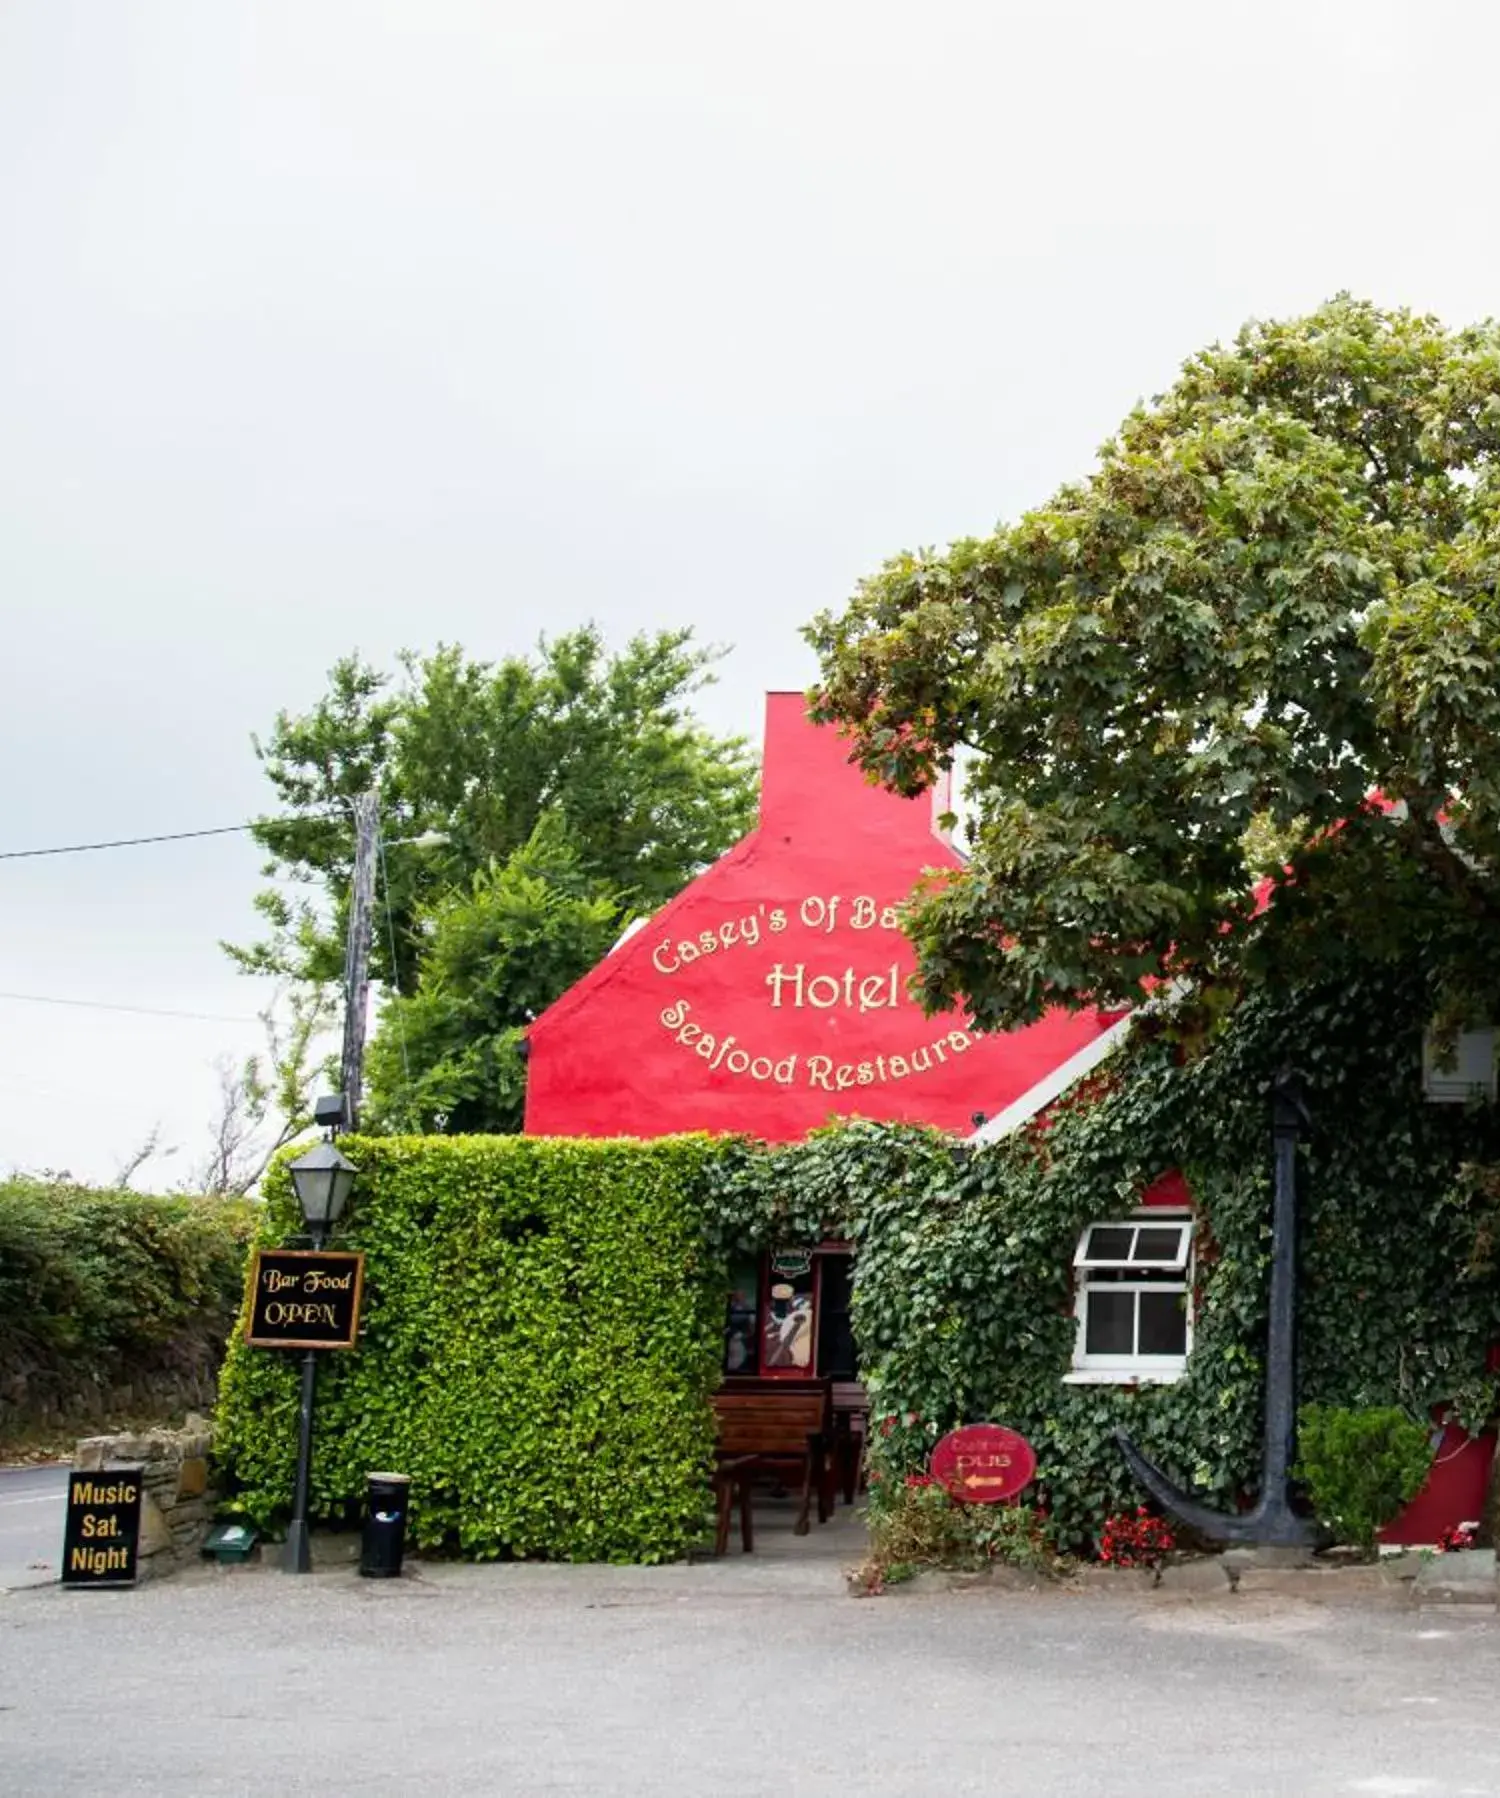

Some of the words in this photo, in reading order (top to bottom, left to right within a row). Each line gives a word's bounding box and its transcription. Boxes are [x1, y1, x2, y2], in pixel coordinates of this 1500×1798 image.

[652, 903, 787, 973] Casey's
[800, 895, 841, 934] Of
[850, 895, 899, 929] Ba
[765, 963, 899, 1013] Hotel
[660, 999, 798, 1084] Seafood
[806, 1027, 984, 1092] Restaura
[262, 1269, 299, 1293] Bar
[303, 1270, 353, 1294] Food
[264, 1301, 340, 1329] OPEN
[73, 1481, 137, 1505] Music
[81, 1513, 123, 1537] Sat.
[71, 1547, 129, 1575] Night
